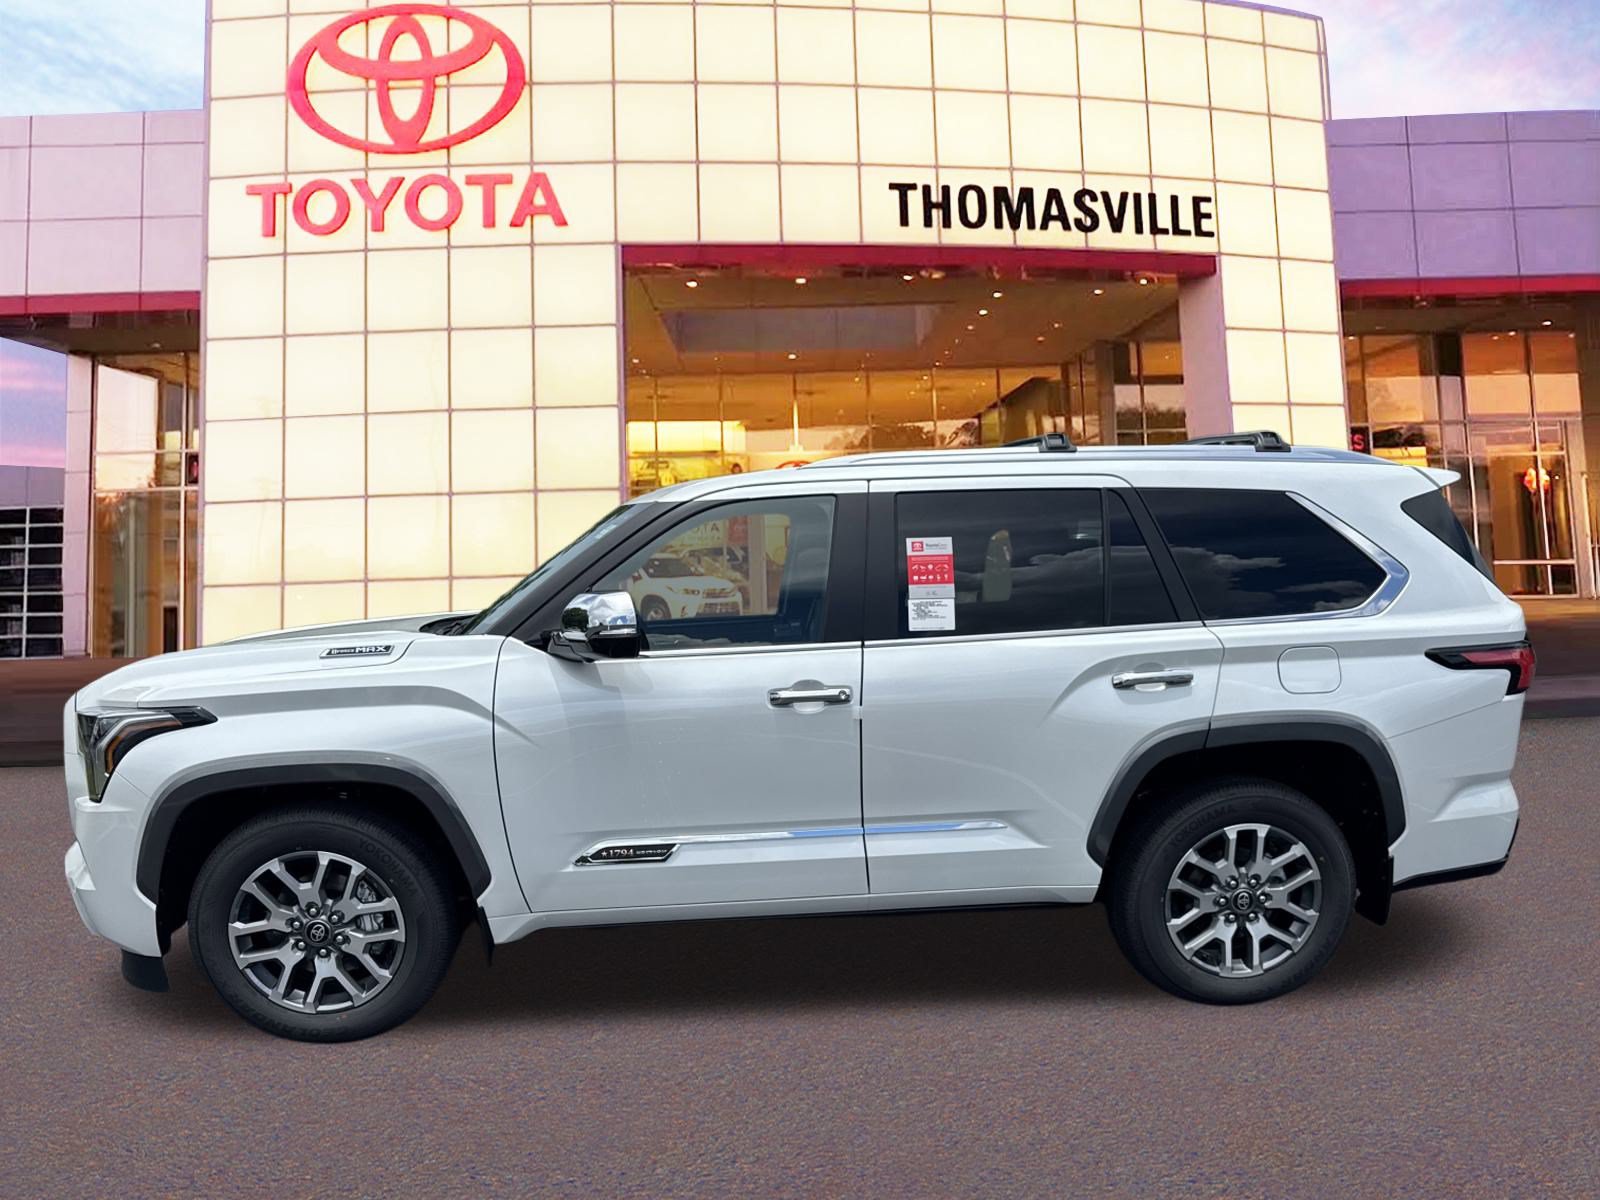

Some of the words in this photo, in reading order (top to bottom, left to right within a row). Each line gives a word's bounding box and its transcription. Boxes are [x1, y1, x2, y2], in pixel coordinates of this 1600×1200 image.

[246, 171, 568, 237] TOYOTA
[888, 182, 1215, 238] THOMASVILLE
[360, 838, 419, 897] YOKOHAMA
[609, 848, 633, 857] 1794
